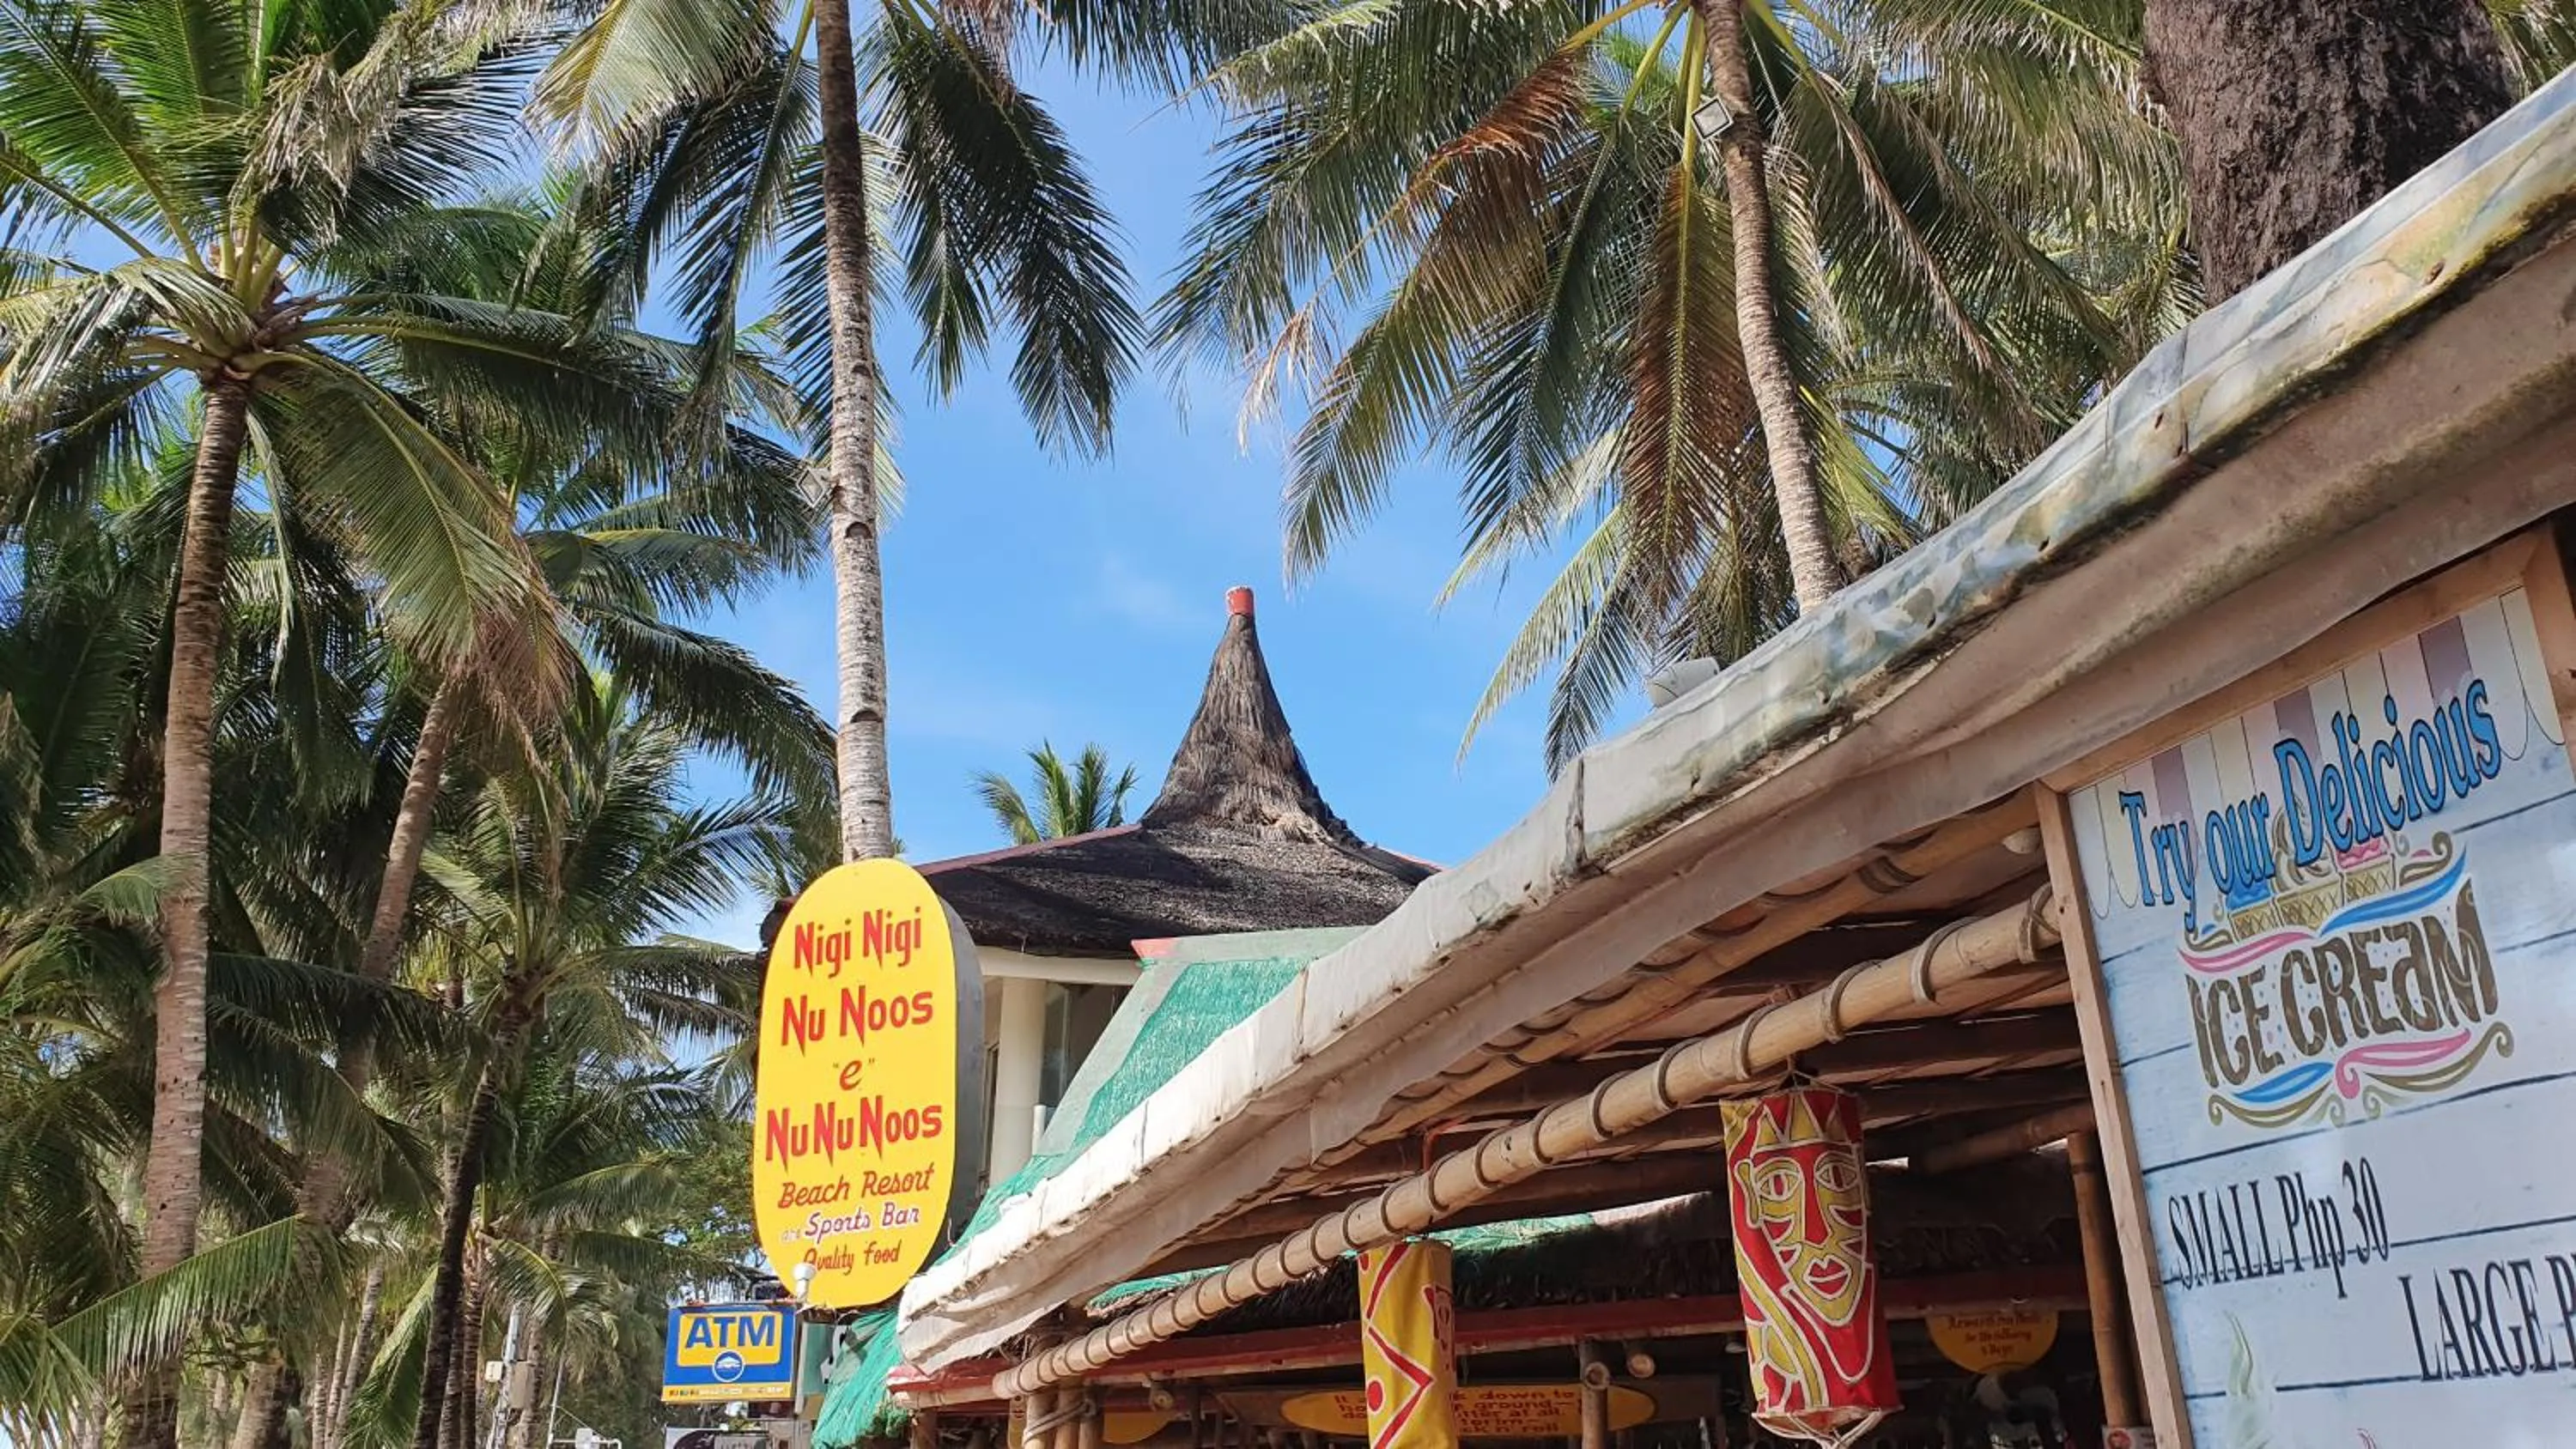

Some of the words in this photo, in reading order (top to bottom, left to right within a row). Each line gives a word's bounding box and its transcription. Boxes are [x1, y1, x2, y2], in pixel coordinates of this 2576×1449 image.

[2118, 791, 2197, 932] Try
[2204, 791, 2276, 898] our
[2273, 679, 2502, 867] Delicious
[793, 920, 852, 979] Nigi
[862, 906, 921, 967] Nigi
[781, 994, 825, 1056] Nu
[839, 985, 934, 1046] Noos
[2185, 963, 2286, 1090] ICE
[778, 1173, 850, 1210] Beach
[861, 1162, 935, 1199] Resort
[805, 1208, 871, 1245] Sports
[881, 1203, 920, 1228] Bar
[2166, 1174, 2286, 1291] SMALL
[2274, 1171, 2348, 1299] Php
[2342, 1155, 2390, 1264] 30
[684, 1315, 775, 1349] ATM
[2397, 1257, 2558, 1382] LARGE
[2545, 1253, 2576, 1371] P
[1479, 1390, 1546, 1400] down
[1554, 1389, 1575, 1399] to
